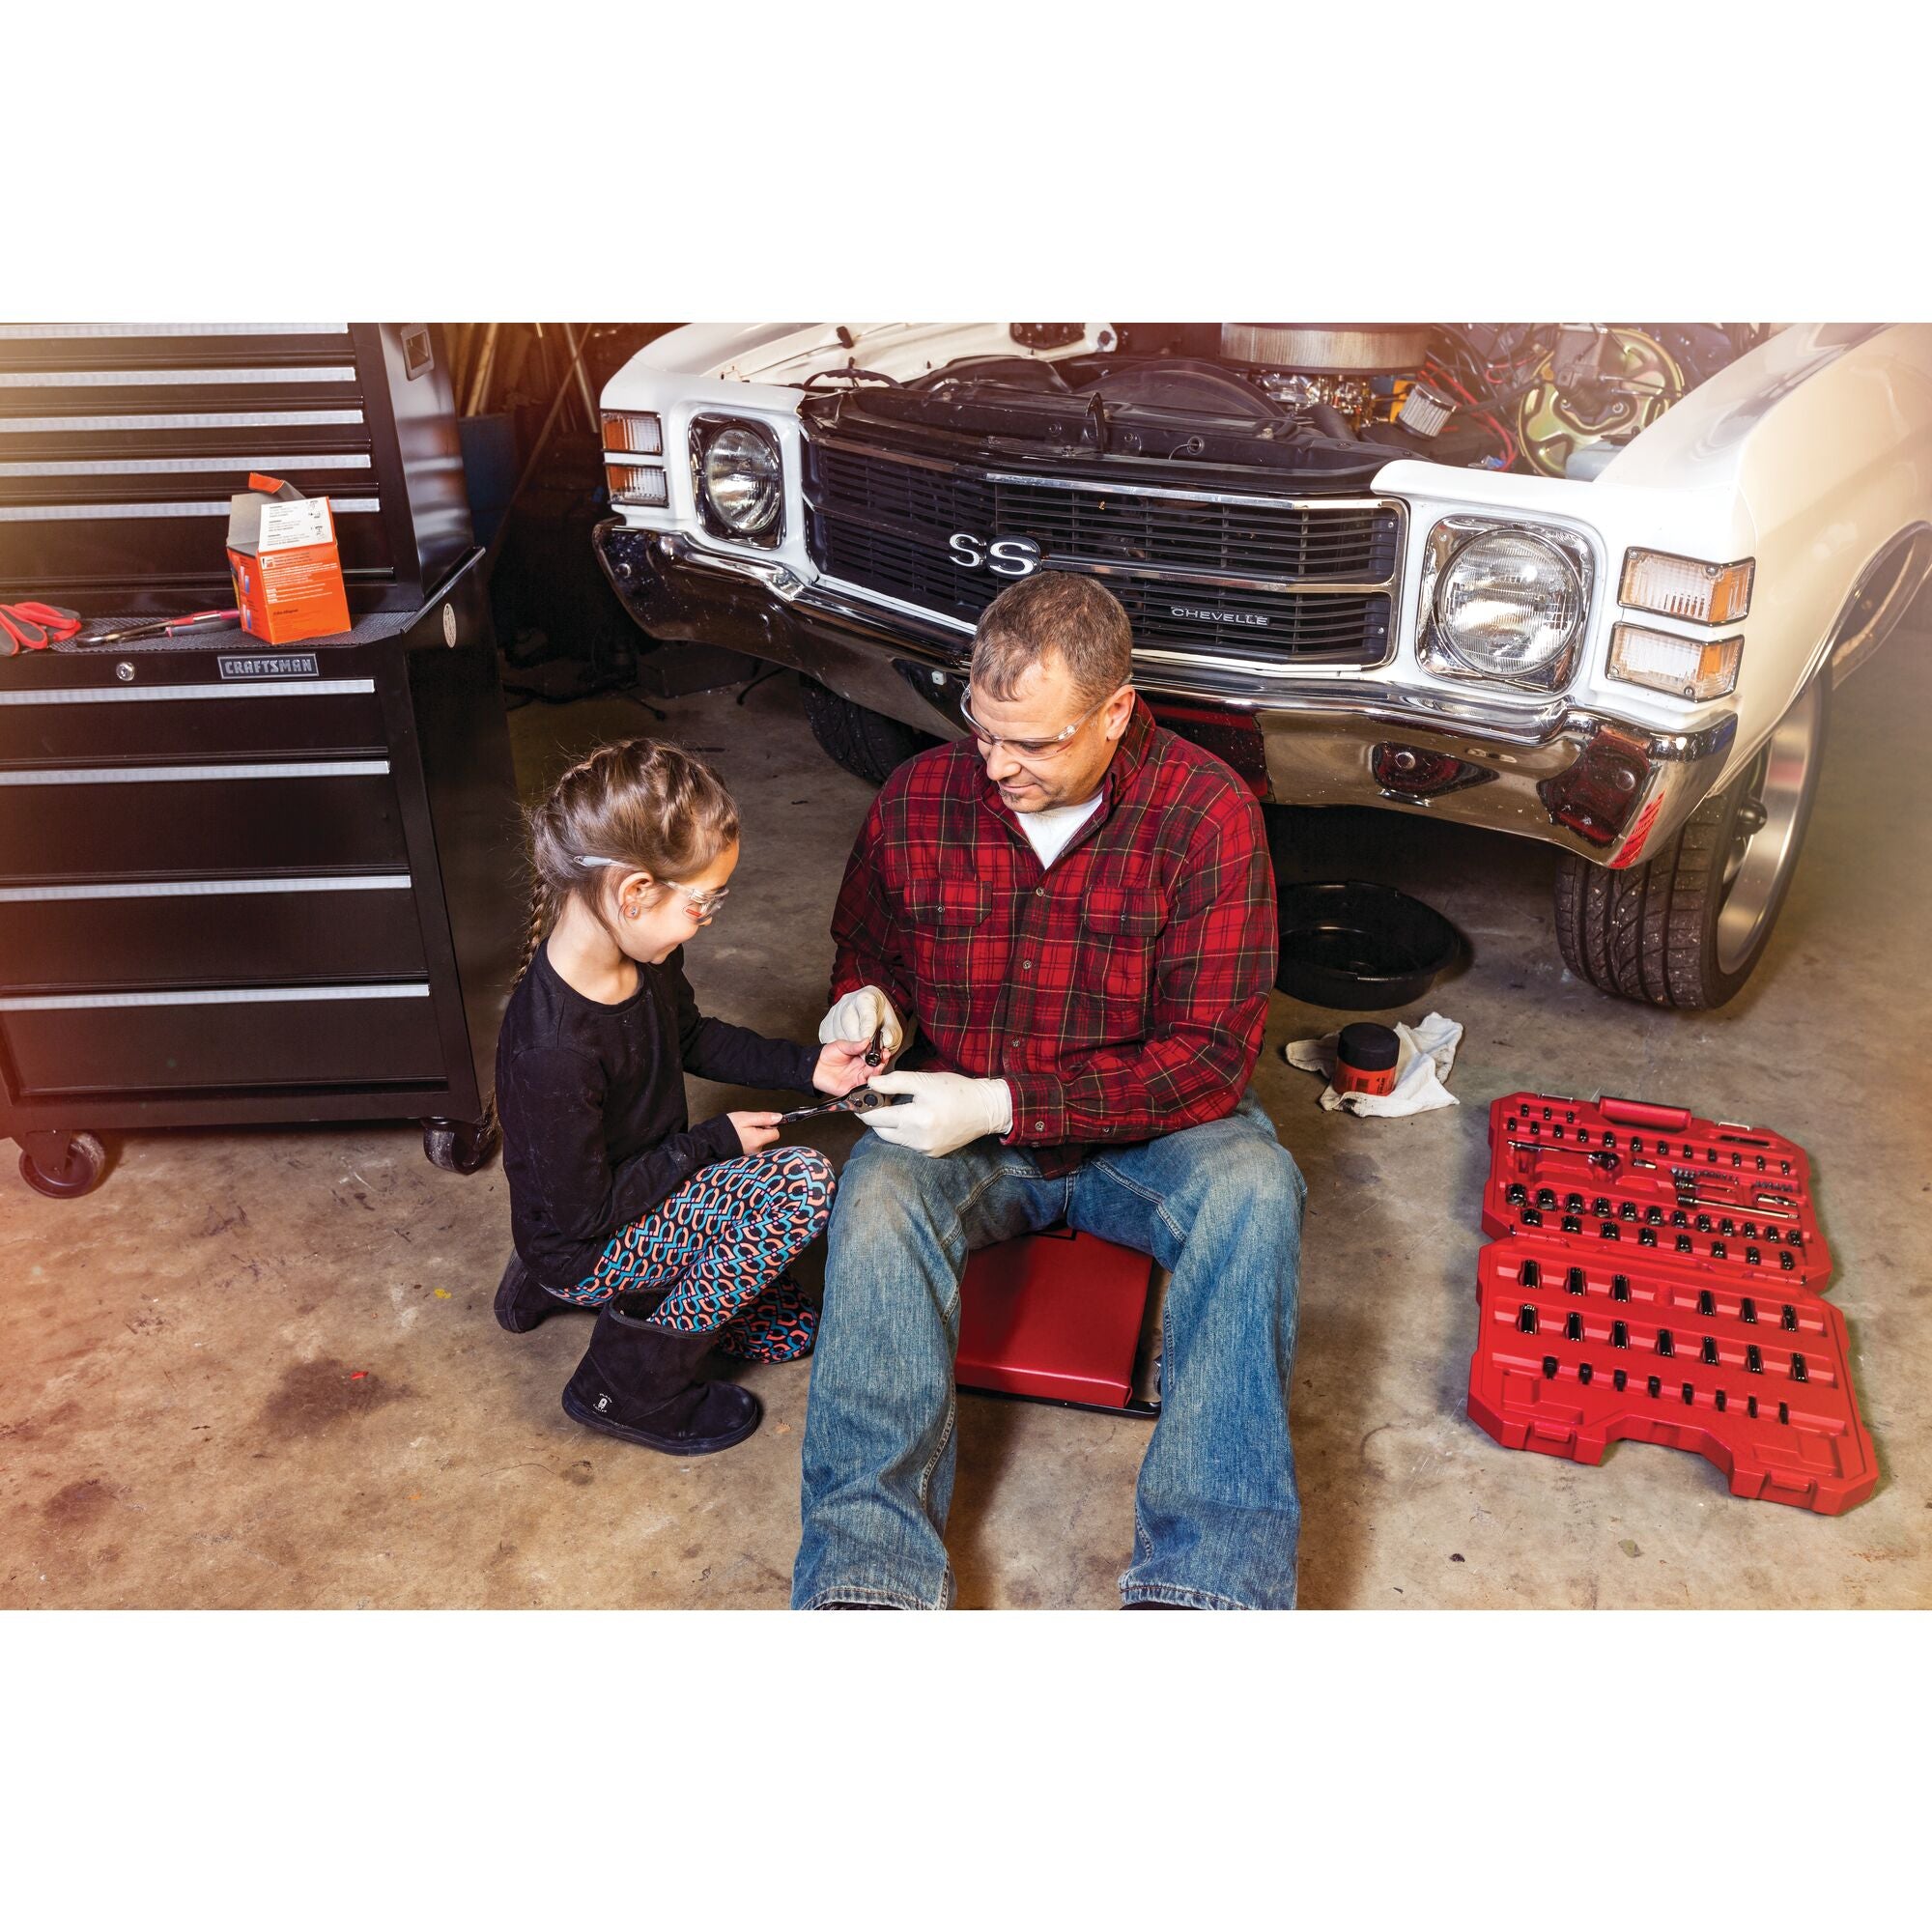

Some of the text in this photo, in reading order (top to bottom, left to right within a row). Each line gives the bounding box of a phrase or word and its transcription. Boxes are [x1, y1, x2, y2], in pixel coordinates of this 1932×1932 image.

[949, 533, 1037, 575] SS
[1171, 608, 1268, 626] CHEVELLE
[224, 659, 312, 674] CRAFTSMAN
